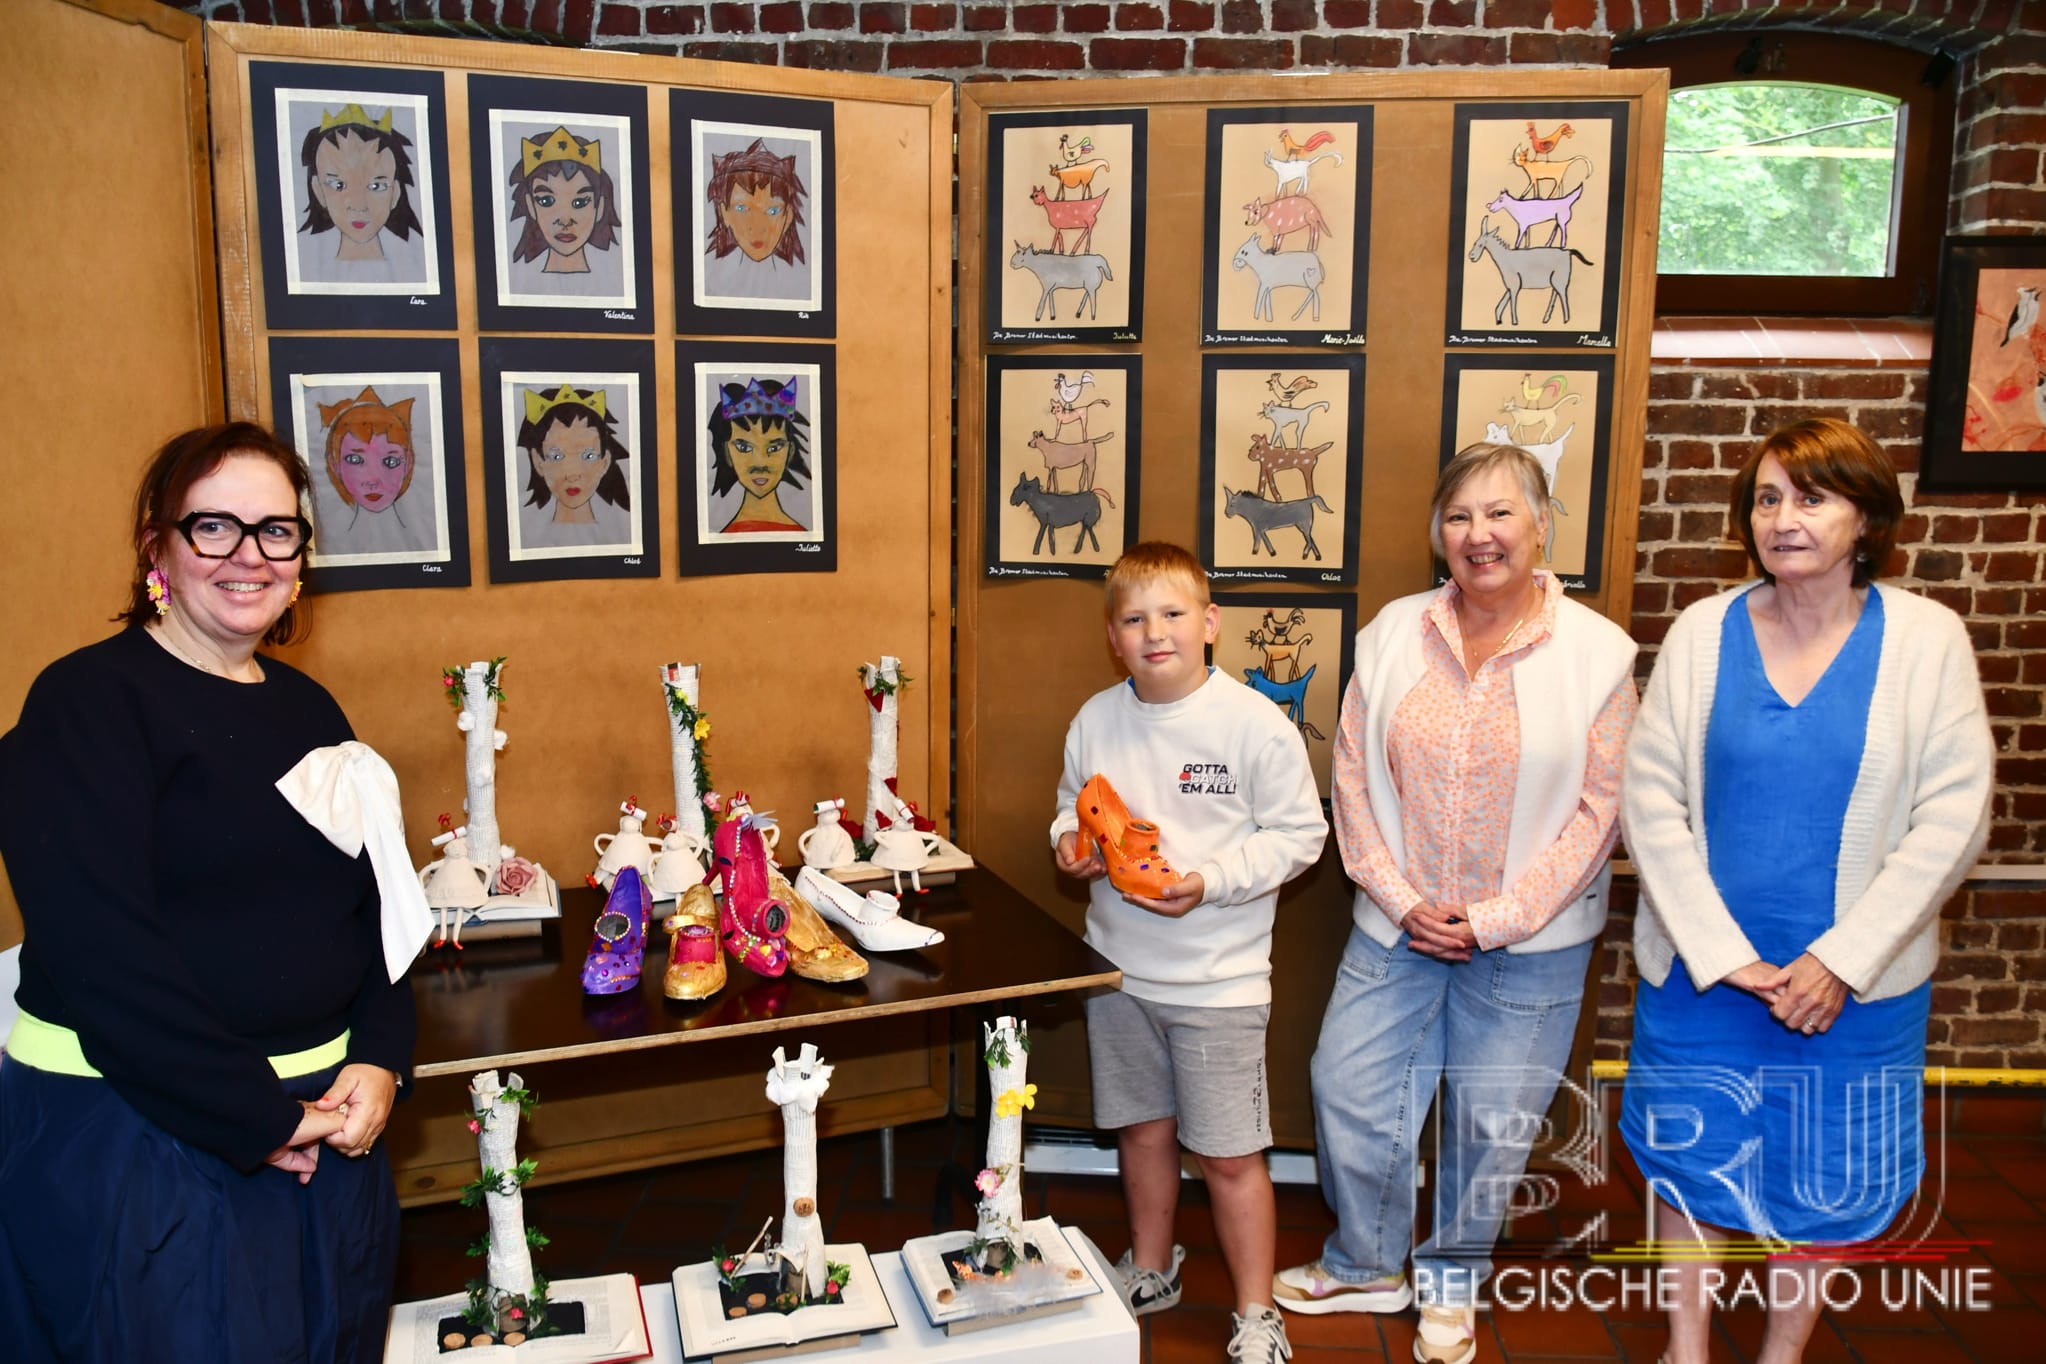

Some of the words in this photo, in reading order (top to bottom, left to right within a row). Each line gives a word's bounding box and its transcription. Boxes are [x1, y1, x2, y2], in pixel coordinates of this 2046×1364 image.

[1183, 764, 1228, 774] GOTTA
[1190, 774, 1237, 784] CATCH
[1179, 783, 1203, 793] 'EM
[1205, 784, 1237, 794] ALL!
